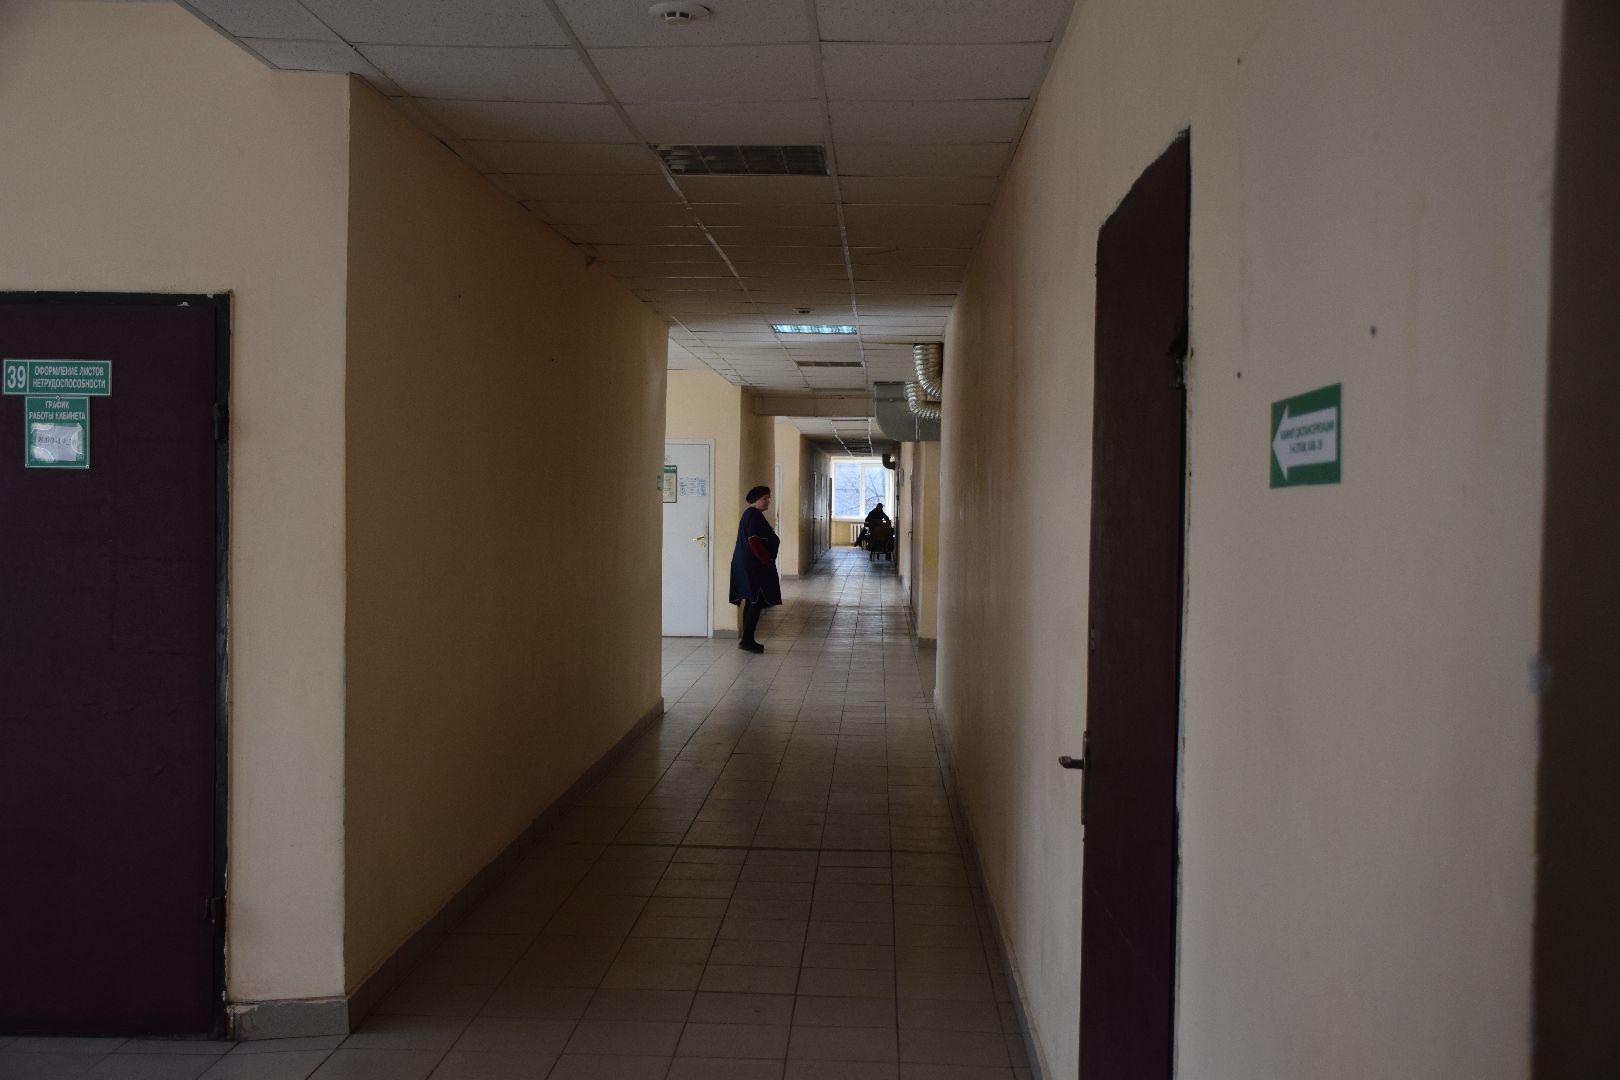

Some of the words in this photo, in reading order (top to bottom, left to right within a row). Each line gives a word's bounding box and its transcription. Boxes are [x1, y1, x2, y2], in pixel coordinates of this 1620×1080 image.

[34, 366, 78, 376] ОФОРМЛЕНИЕ
[79, 366, 105, 376] ЛИСТОВ
[7, 365, 26, 389] 39
[32, 378, 106, 389] НЕТРУДОСПОСОБНОСТИ
[45, 400, 70, 409] ГРАФИК
[28, 411, 54, 420] РАБОТЫ
[55, 411, 86, 420] КАБИНЕТА
